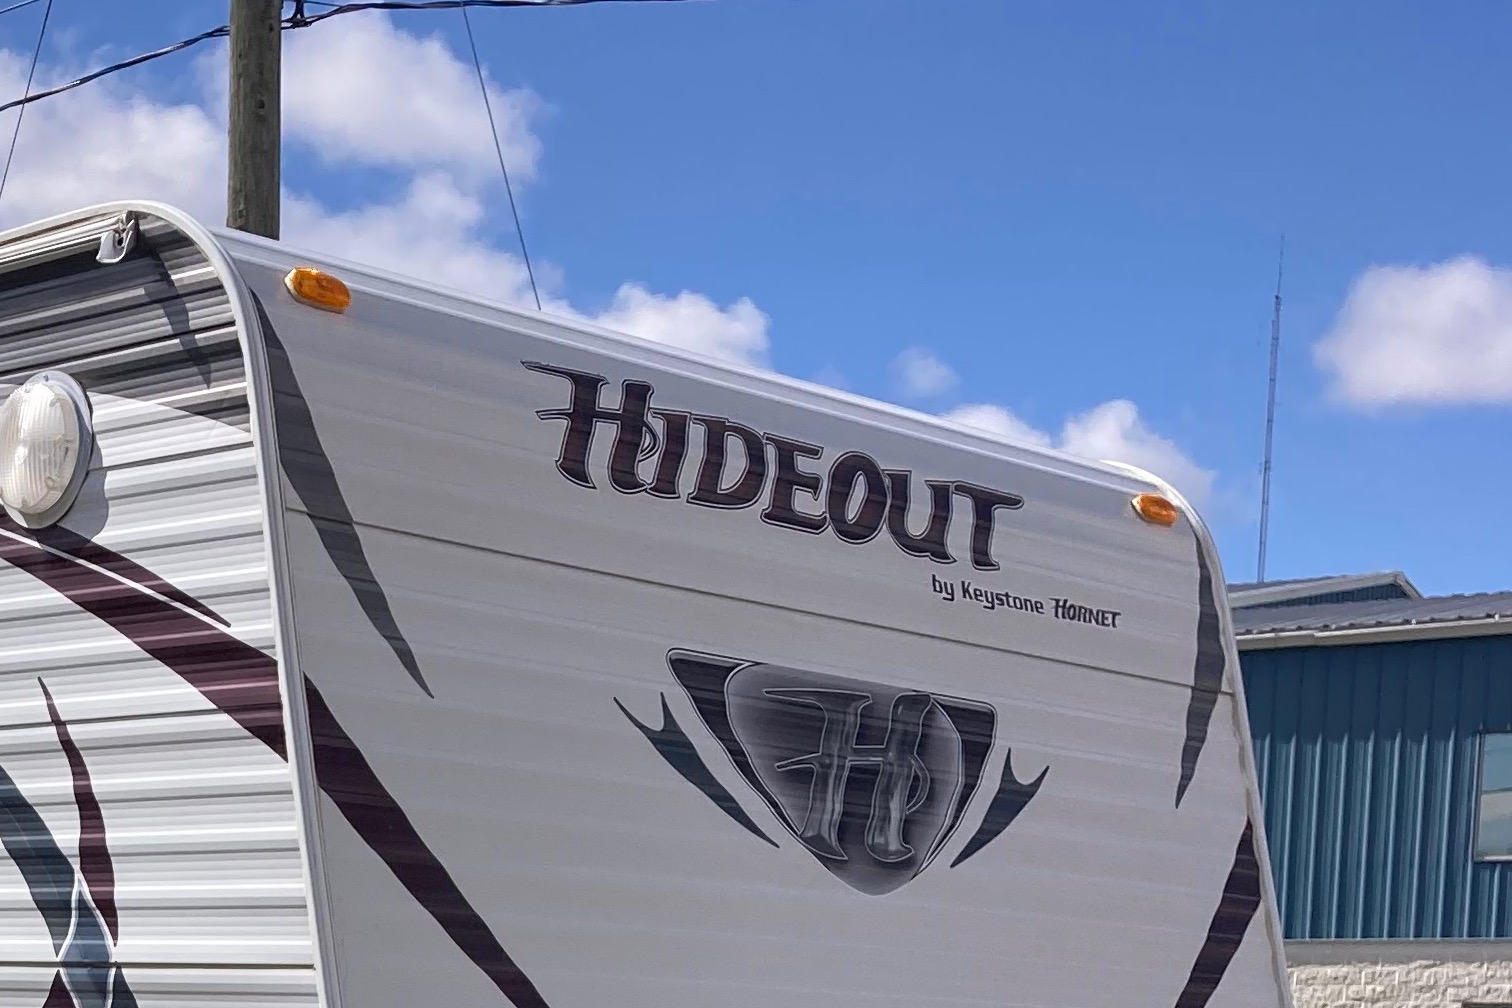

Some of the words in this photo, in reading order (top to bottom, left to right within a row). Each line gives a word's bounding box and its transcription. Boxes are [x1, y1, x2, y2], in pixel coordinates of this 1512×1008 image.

[521, 359, 1024, 571] HIDEOUT
[931, 574, 955, 602] by
[961, 580, 1045, 615] Keystone
[1048, 597, 1122, 629] HORNET
